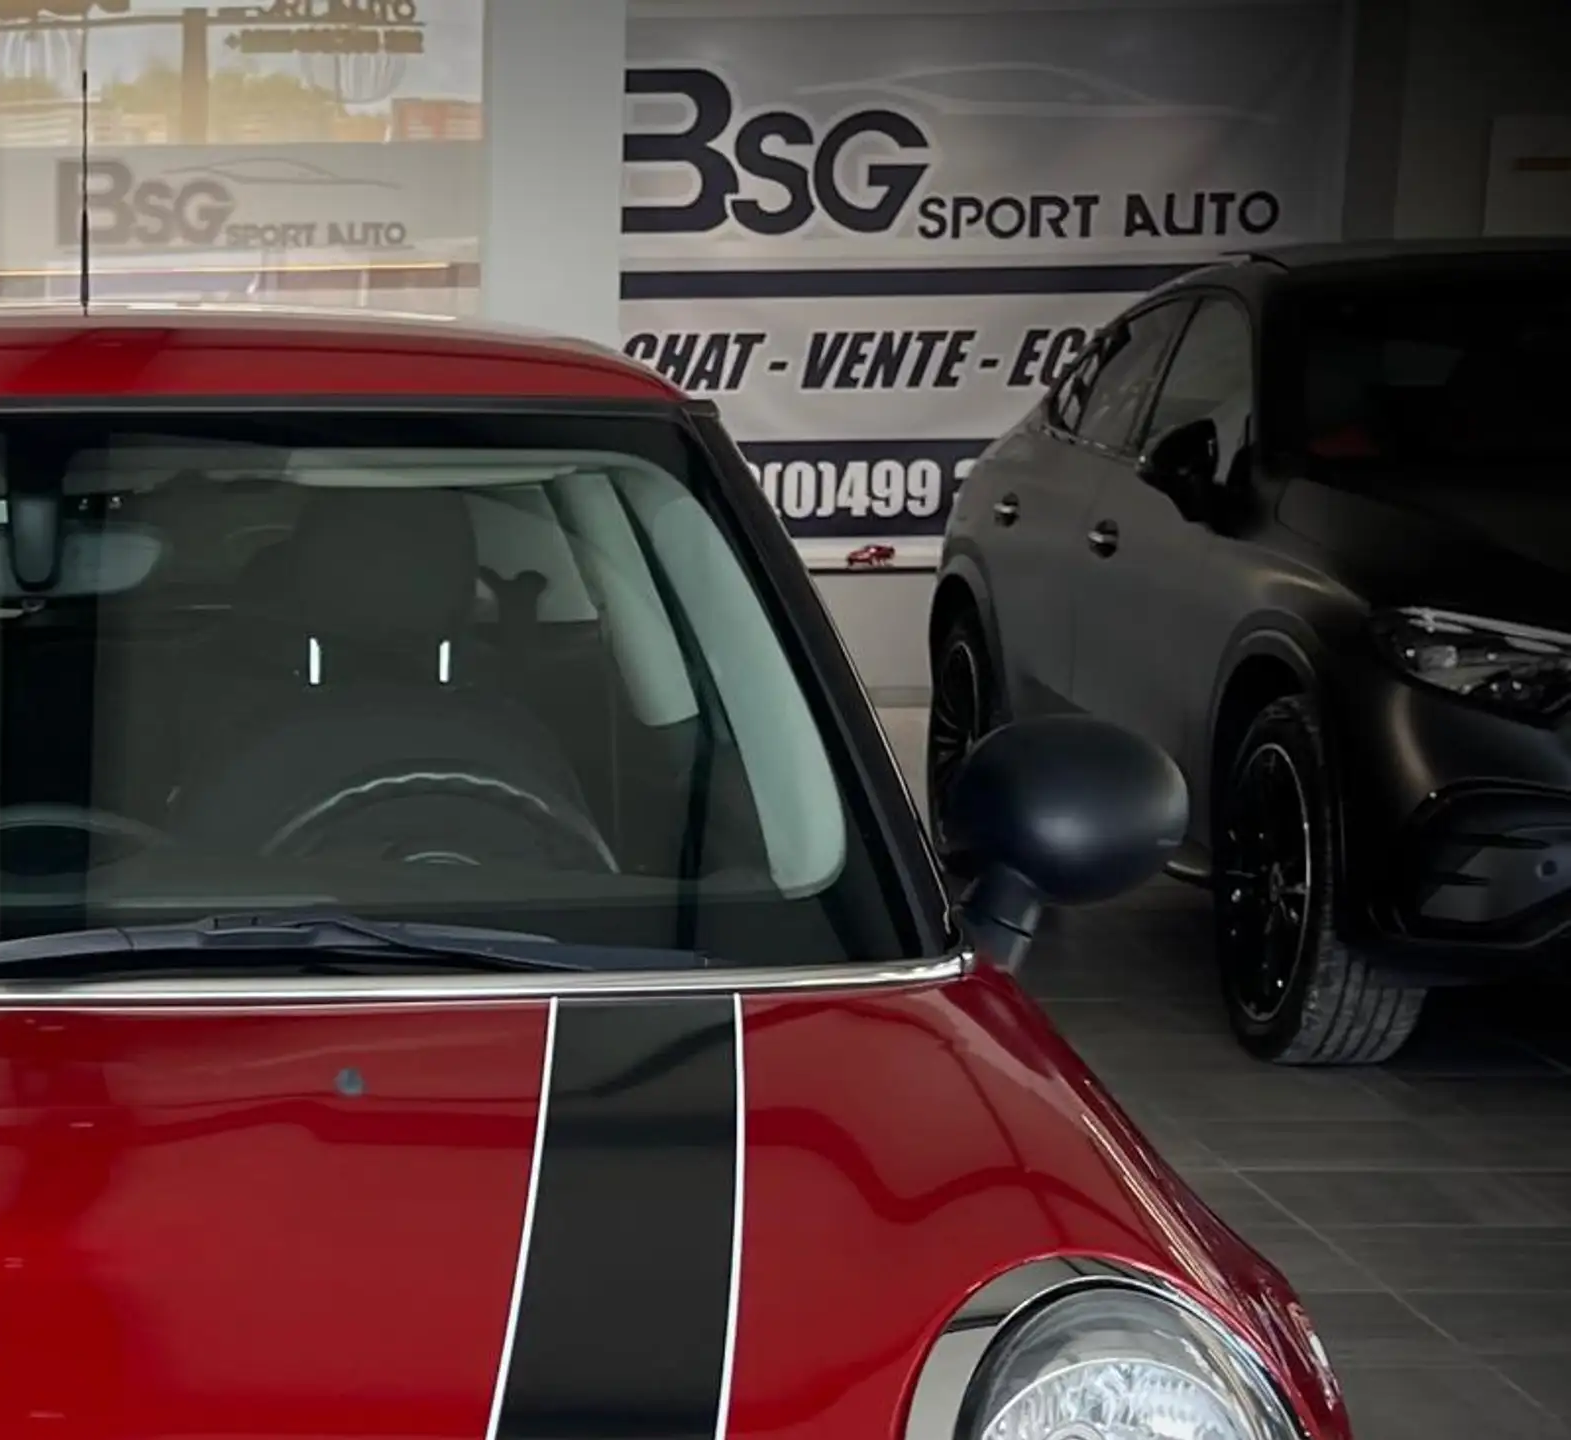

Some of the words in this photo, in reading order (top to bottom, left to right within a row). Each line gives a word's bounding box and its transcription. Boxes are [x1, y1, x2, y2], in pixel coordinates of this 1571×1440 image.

[621, 68, 931, 236] BSG
[917, 195, 1100, 240] SPORT
[1124, 190, 1280, 238] AUTO
[55, 158, 235, 246] BSG
[226, 222, 316, 248] SPORT
[326, 221, 408, 246] AUTO
[800, 330, 977, 389] VENTE
